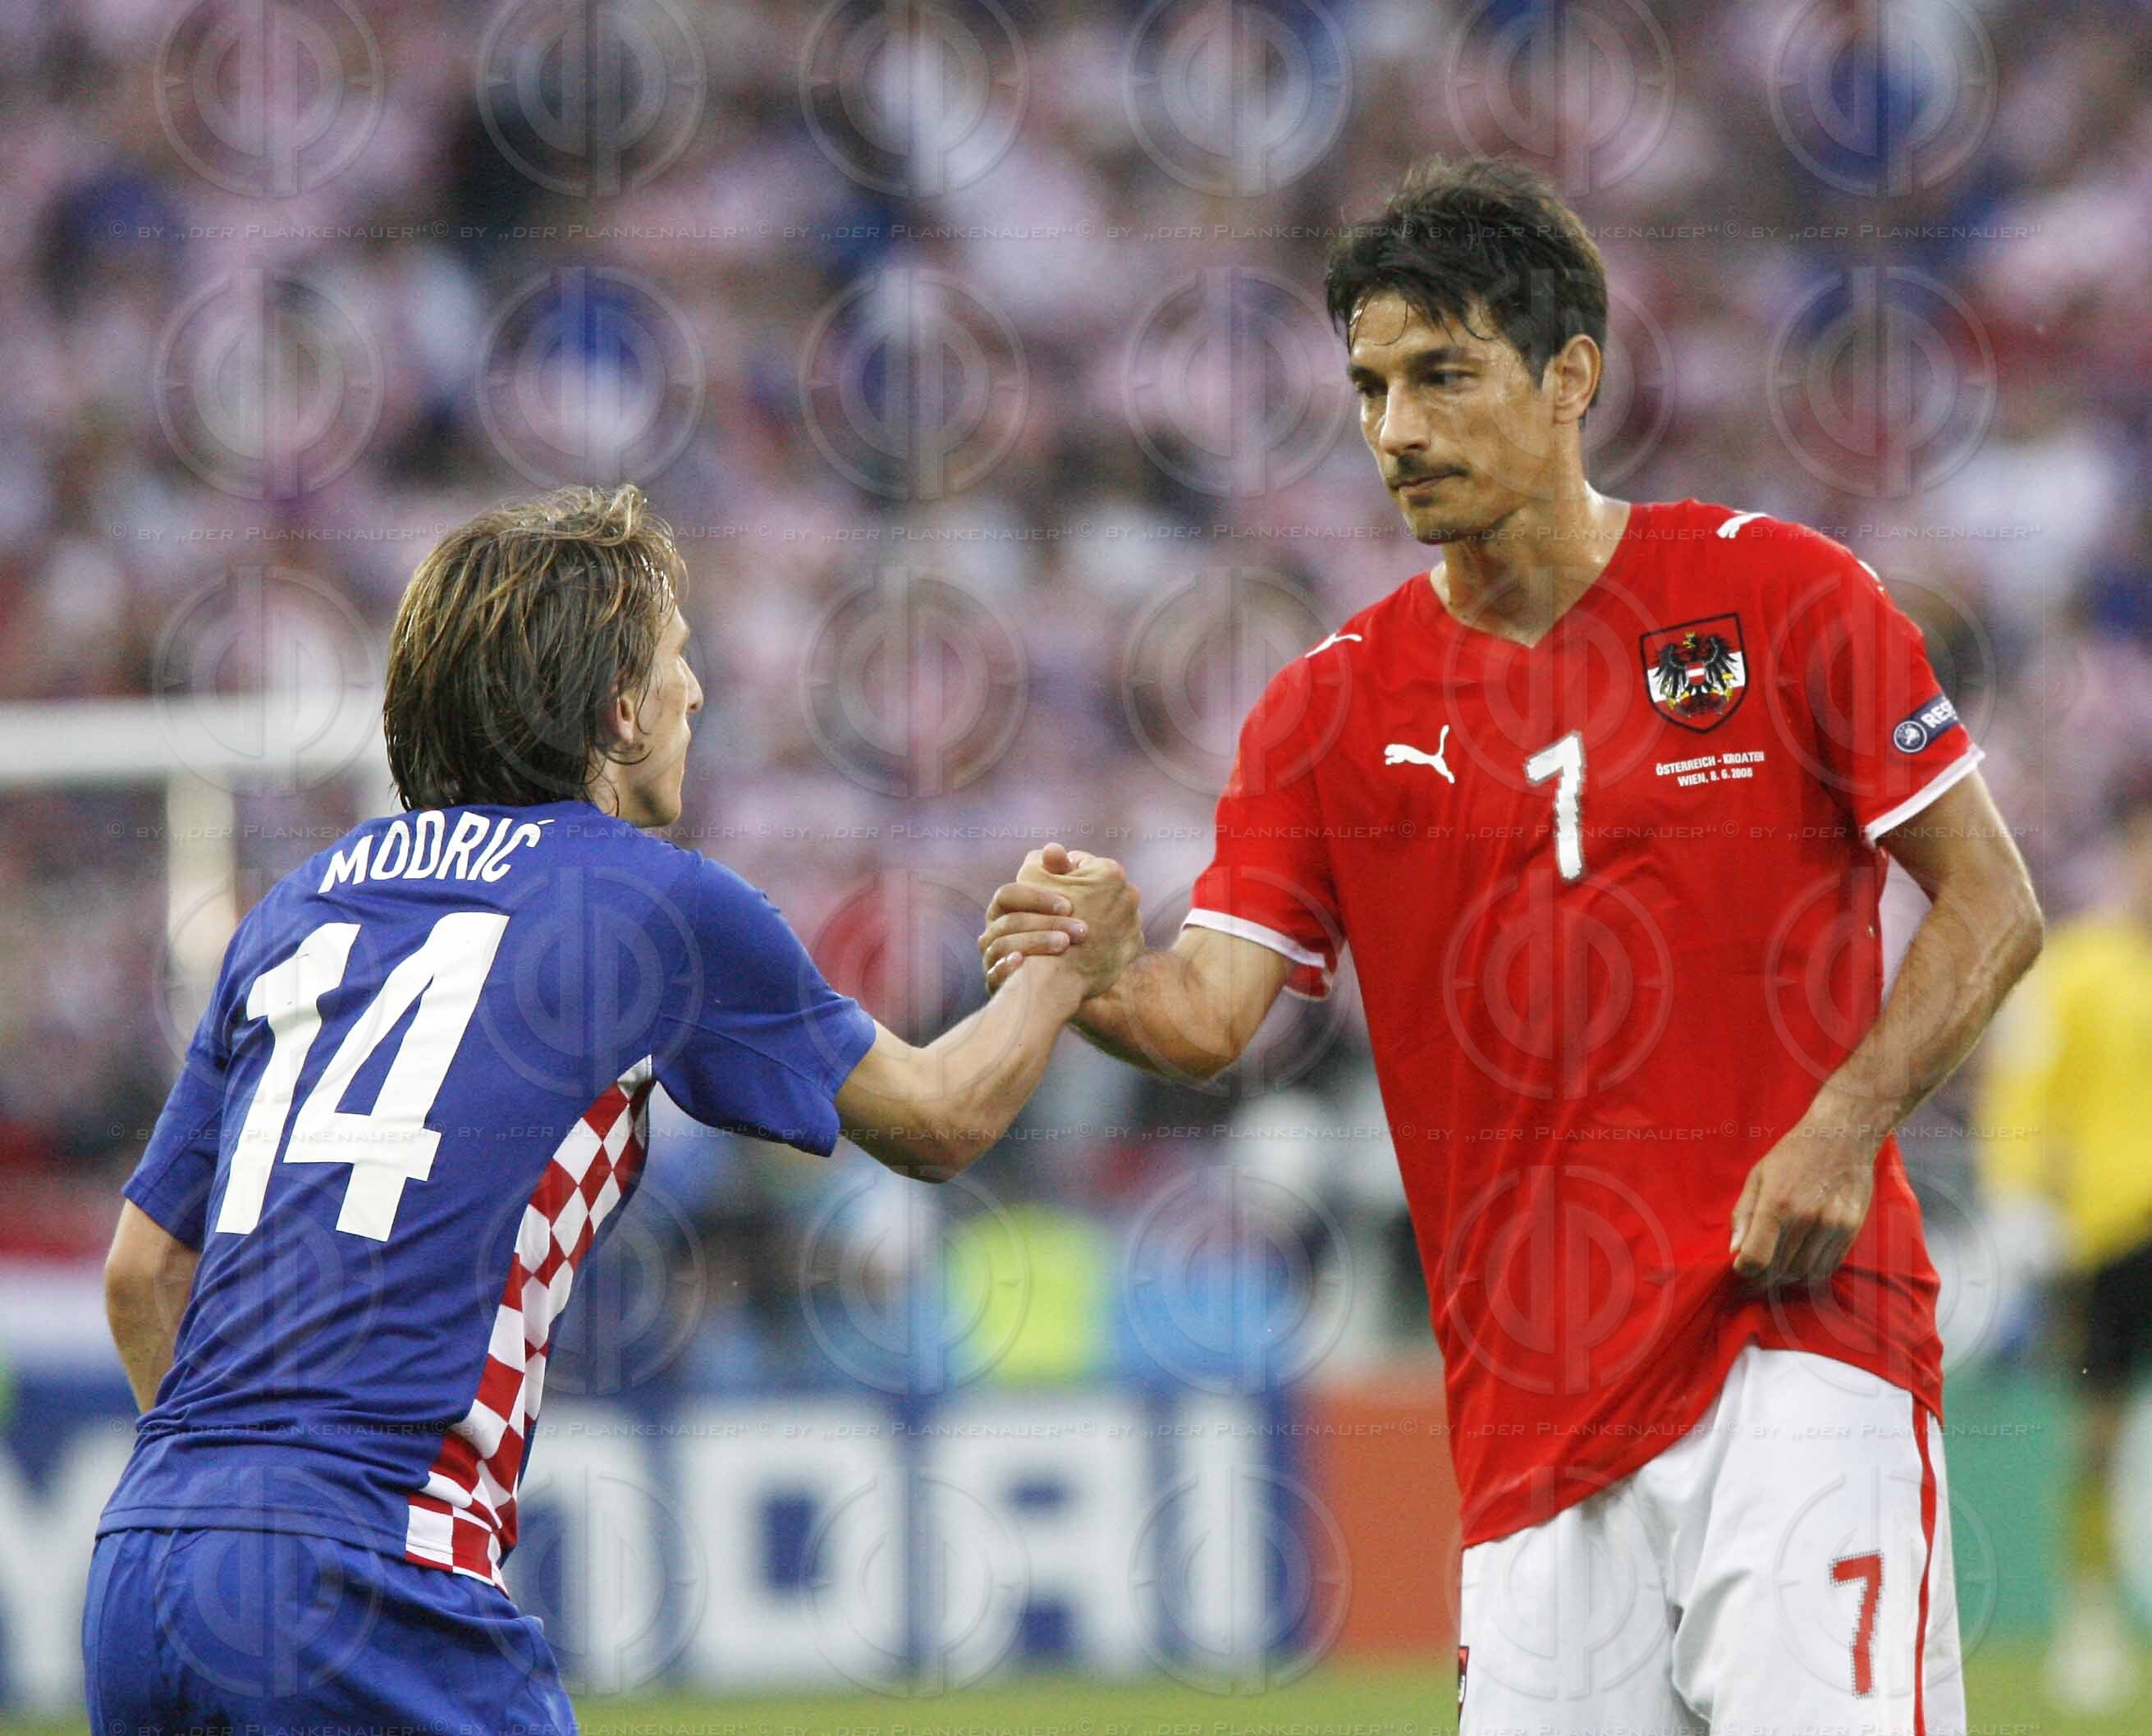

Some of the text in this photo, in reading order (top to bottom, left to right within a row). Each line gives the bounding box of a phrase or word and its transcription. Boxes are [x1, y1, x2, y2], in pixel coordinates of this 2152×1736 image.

[1522, 730, 1588, 882] 7
[1655, 755, 1716, 776] ÖSTERREICH
[318, 808, 555, 894] MODRIĆ
[214, 910, 511, 1243] 14
[1830, 1550, 1884, 1700] 7
